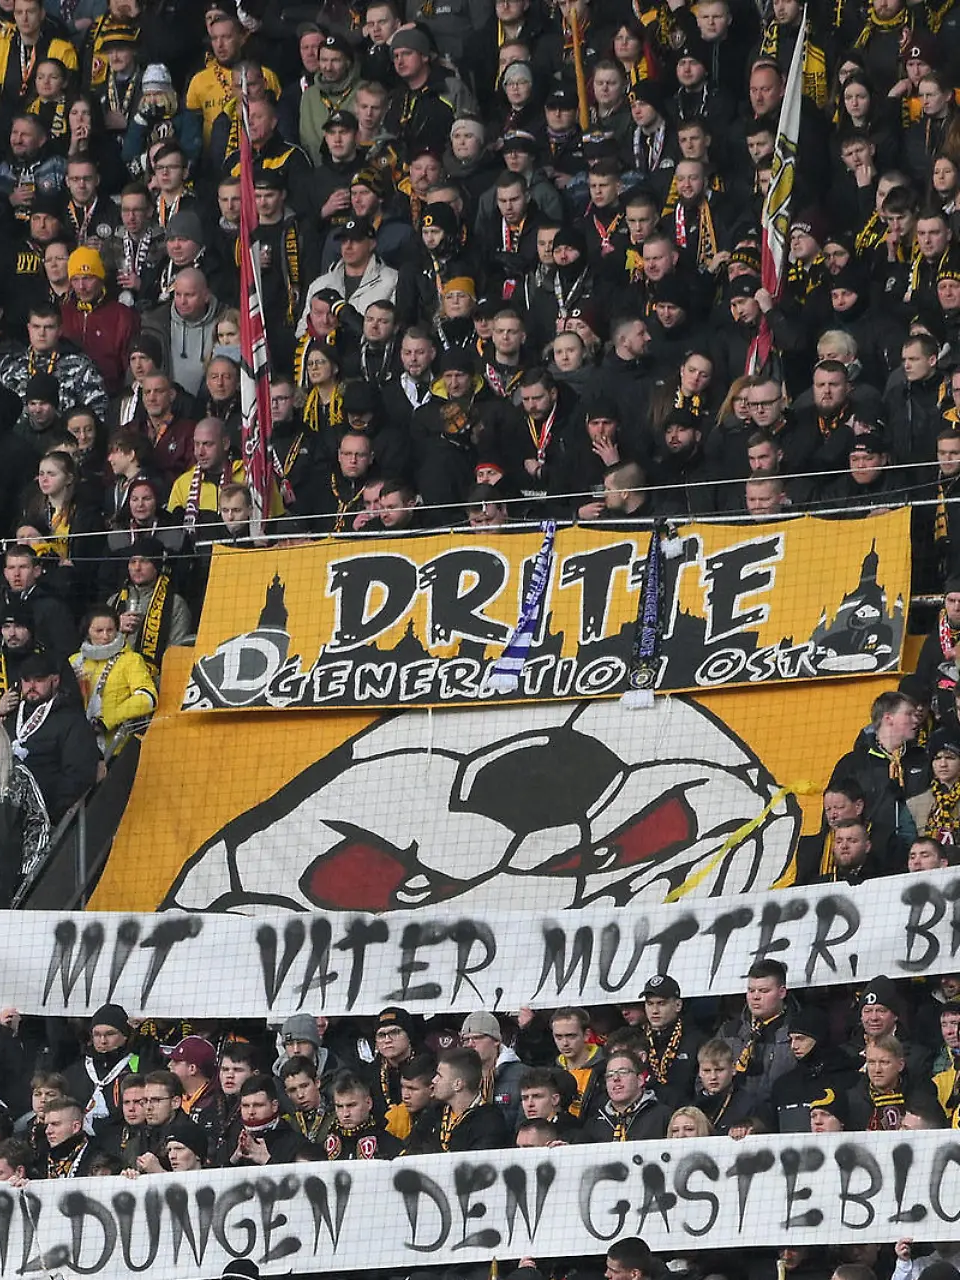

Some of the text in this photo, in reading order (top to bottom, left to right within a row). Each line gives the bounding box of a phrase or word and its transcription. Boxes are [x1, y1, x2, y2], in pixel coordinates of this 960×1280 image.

[326, 531, 785, 650] DRITTE
[265, 655, 668, 707] GENERTIO
[42, 915, 204, 1010] MIT
[256, 914, 504, 1012] VATER,
[531, 893, 860, 999] MUTTER,
[897, 878, 960, 972] B
[393, 1158, 557, 1254] DEN
